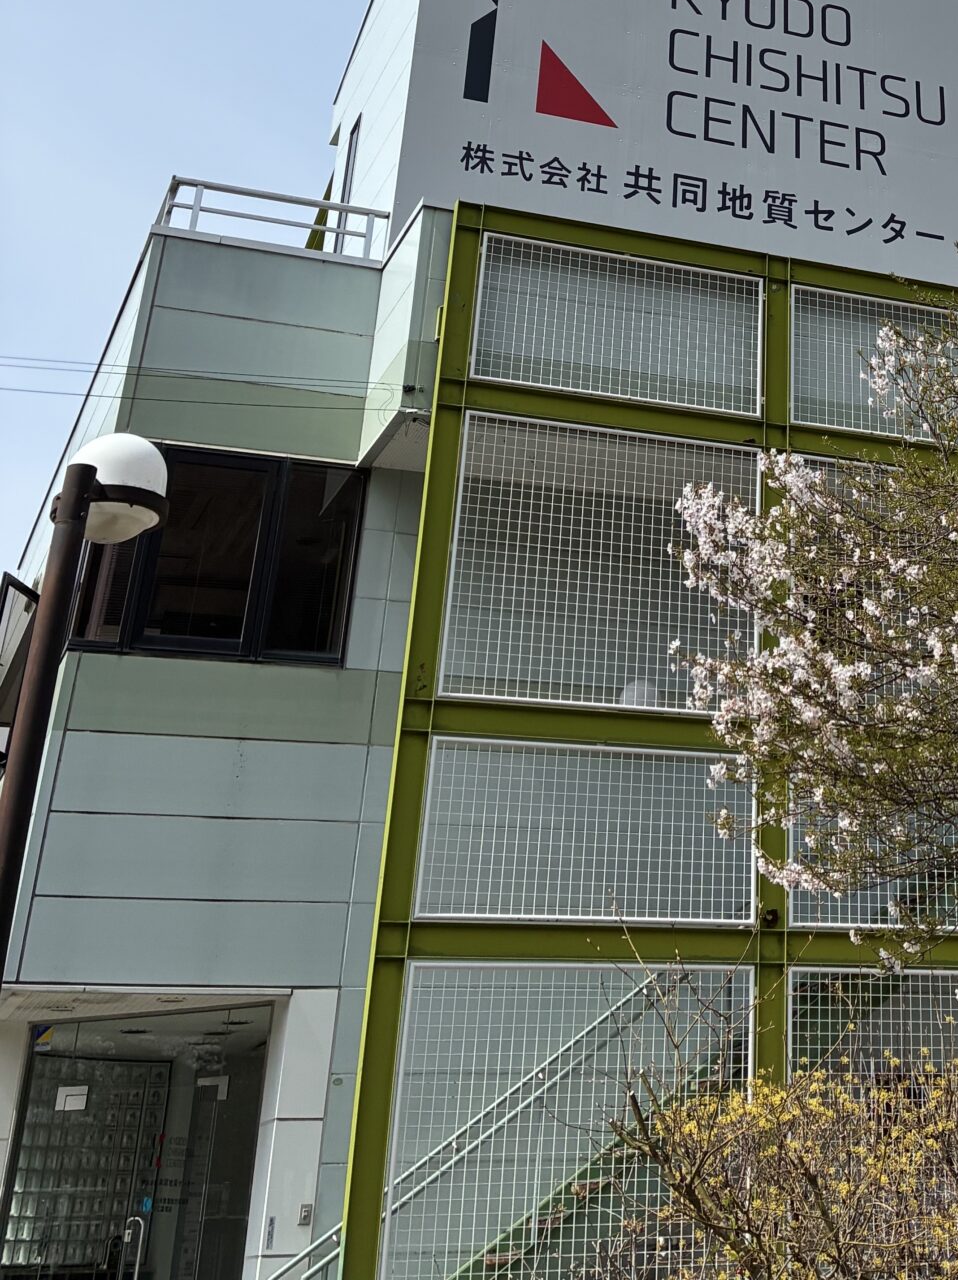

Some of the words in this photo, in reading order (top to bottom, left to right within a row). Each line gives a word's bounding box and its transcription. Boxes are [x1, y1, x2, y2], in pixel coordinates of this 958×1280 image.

[668, 28, 946, 126] CHISHITSU
[666, 90, 888, 176] CENTER
[460, 140, 608, 195] 株式会社
[622, 164, 945, 245] 共同地質センター
